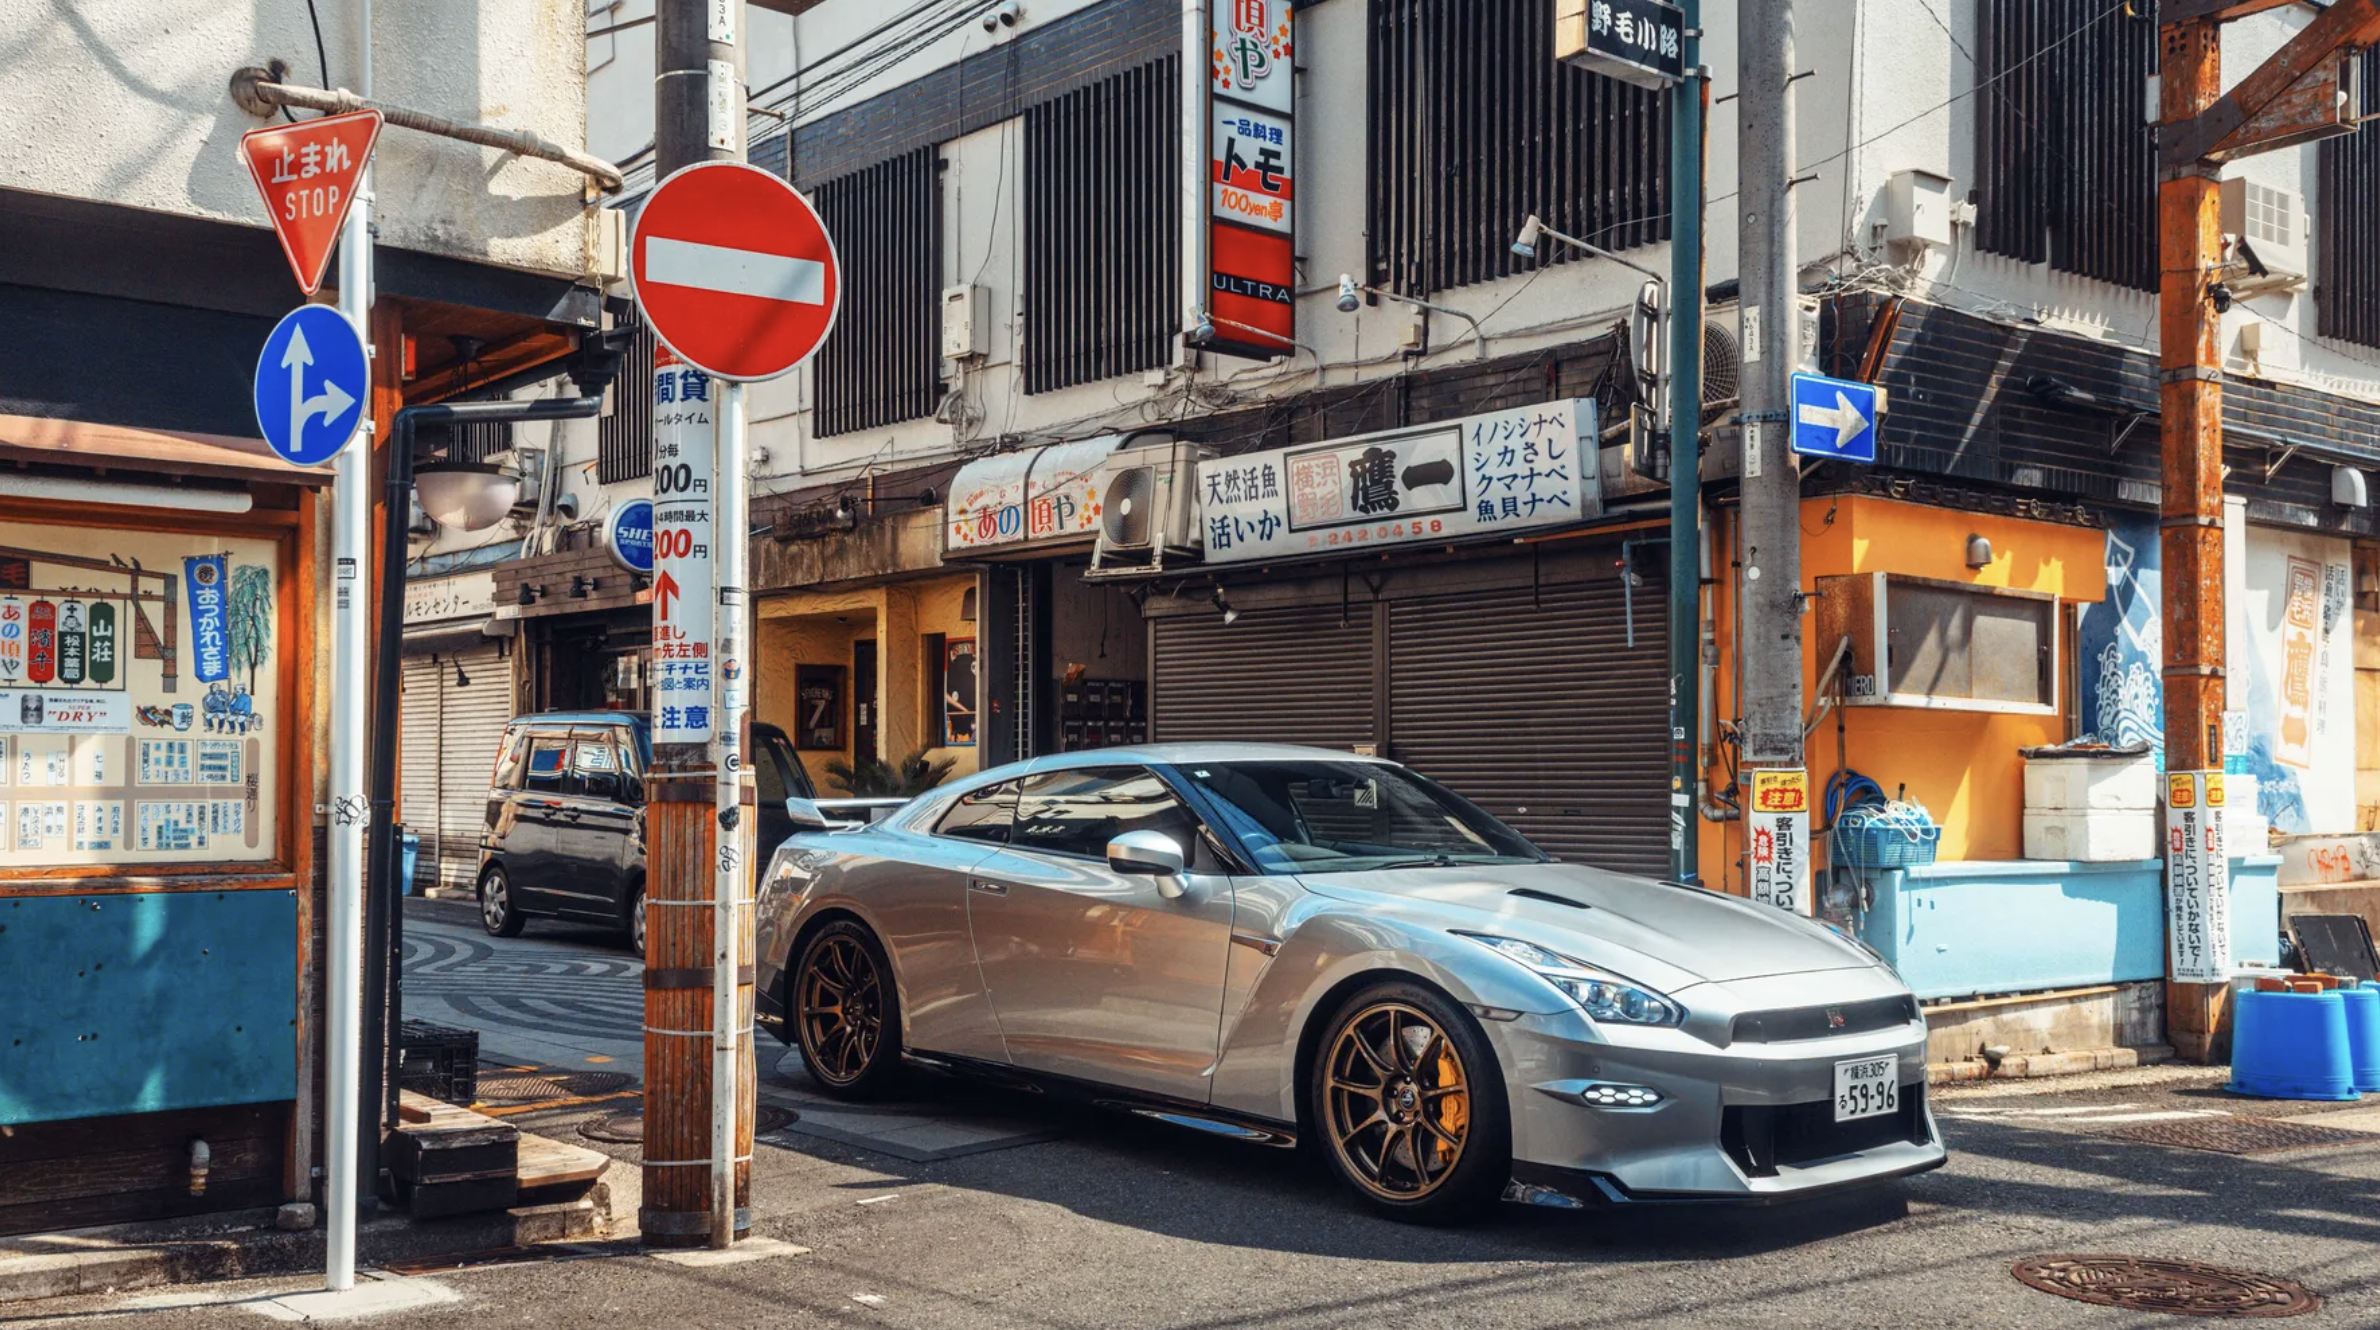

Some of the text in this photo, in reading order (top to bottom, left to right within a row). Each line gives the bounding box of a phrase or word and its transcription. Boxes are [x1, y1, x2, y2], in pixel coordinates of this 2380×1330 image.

[1591, 0, 1679, 59] 野毛小路
[1221, 117, 1284, 145] 一品料理
[271, 136, 351, 184] 止まれ
[1221, 135, 1285, 192] トモ
[284, 185, 340, 221] STOP
[1213, 272, 1291, 303] ULTRA
[1294, 460, 1339, 492] 横浜
[1473, 437, 1567, 471] シカさし
[1206, 463, 1279, 508] 天然活魚
[1348, 447, 1455, 515] 鷹一
[1476, 461, 1569, 499] クマナベ
[977, 494, 1076, 540] あの頃や
[1209, 508, 1282, 550] 活いか
[91, 619, 113, 662] 山荘
[196, 587, 223, 677] おつかれさま
[1775, 816, 1794, 911] 客引きに、つい
[2183, 811, 2202, 968] 客引きに、ついていかないで！
[1849, 1079, 1895, 1115] 59-96
